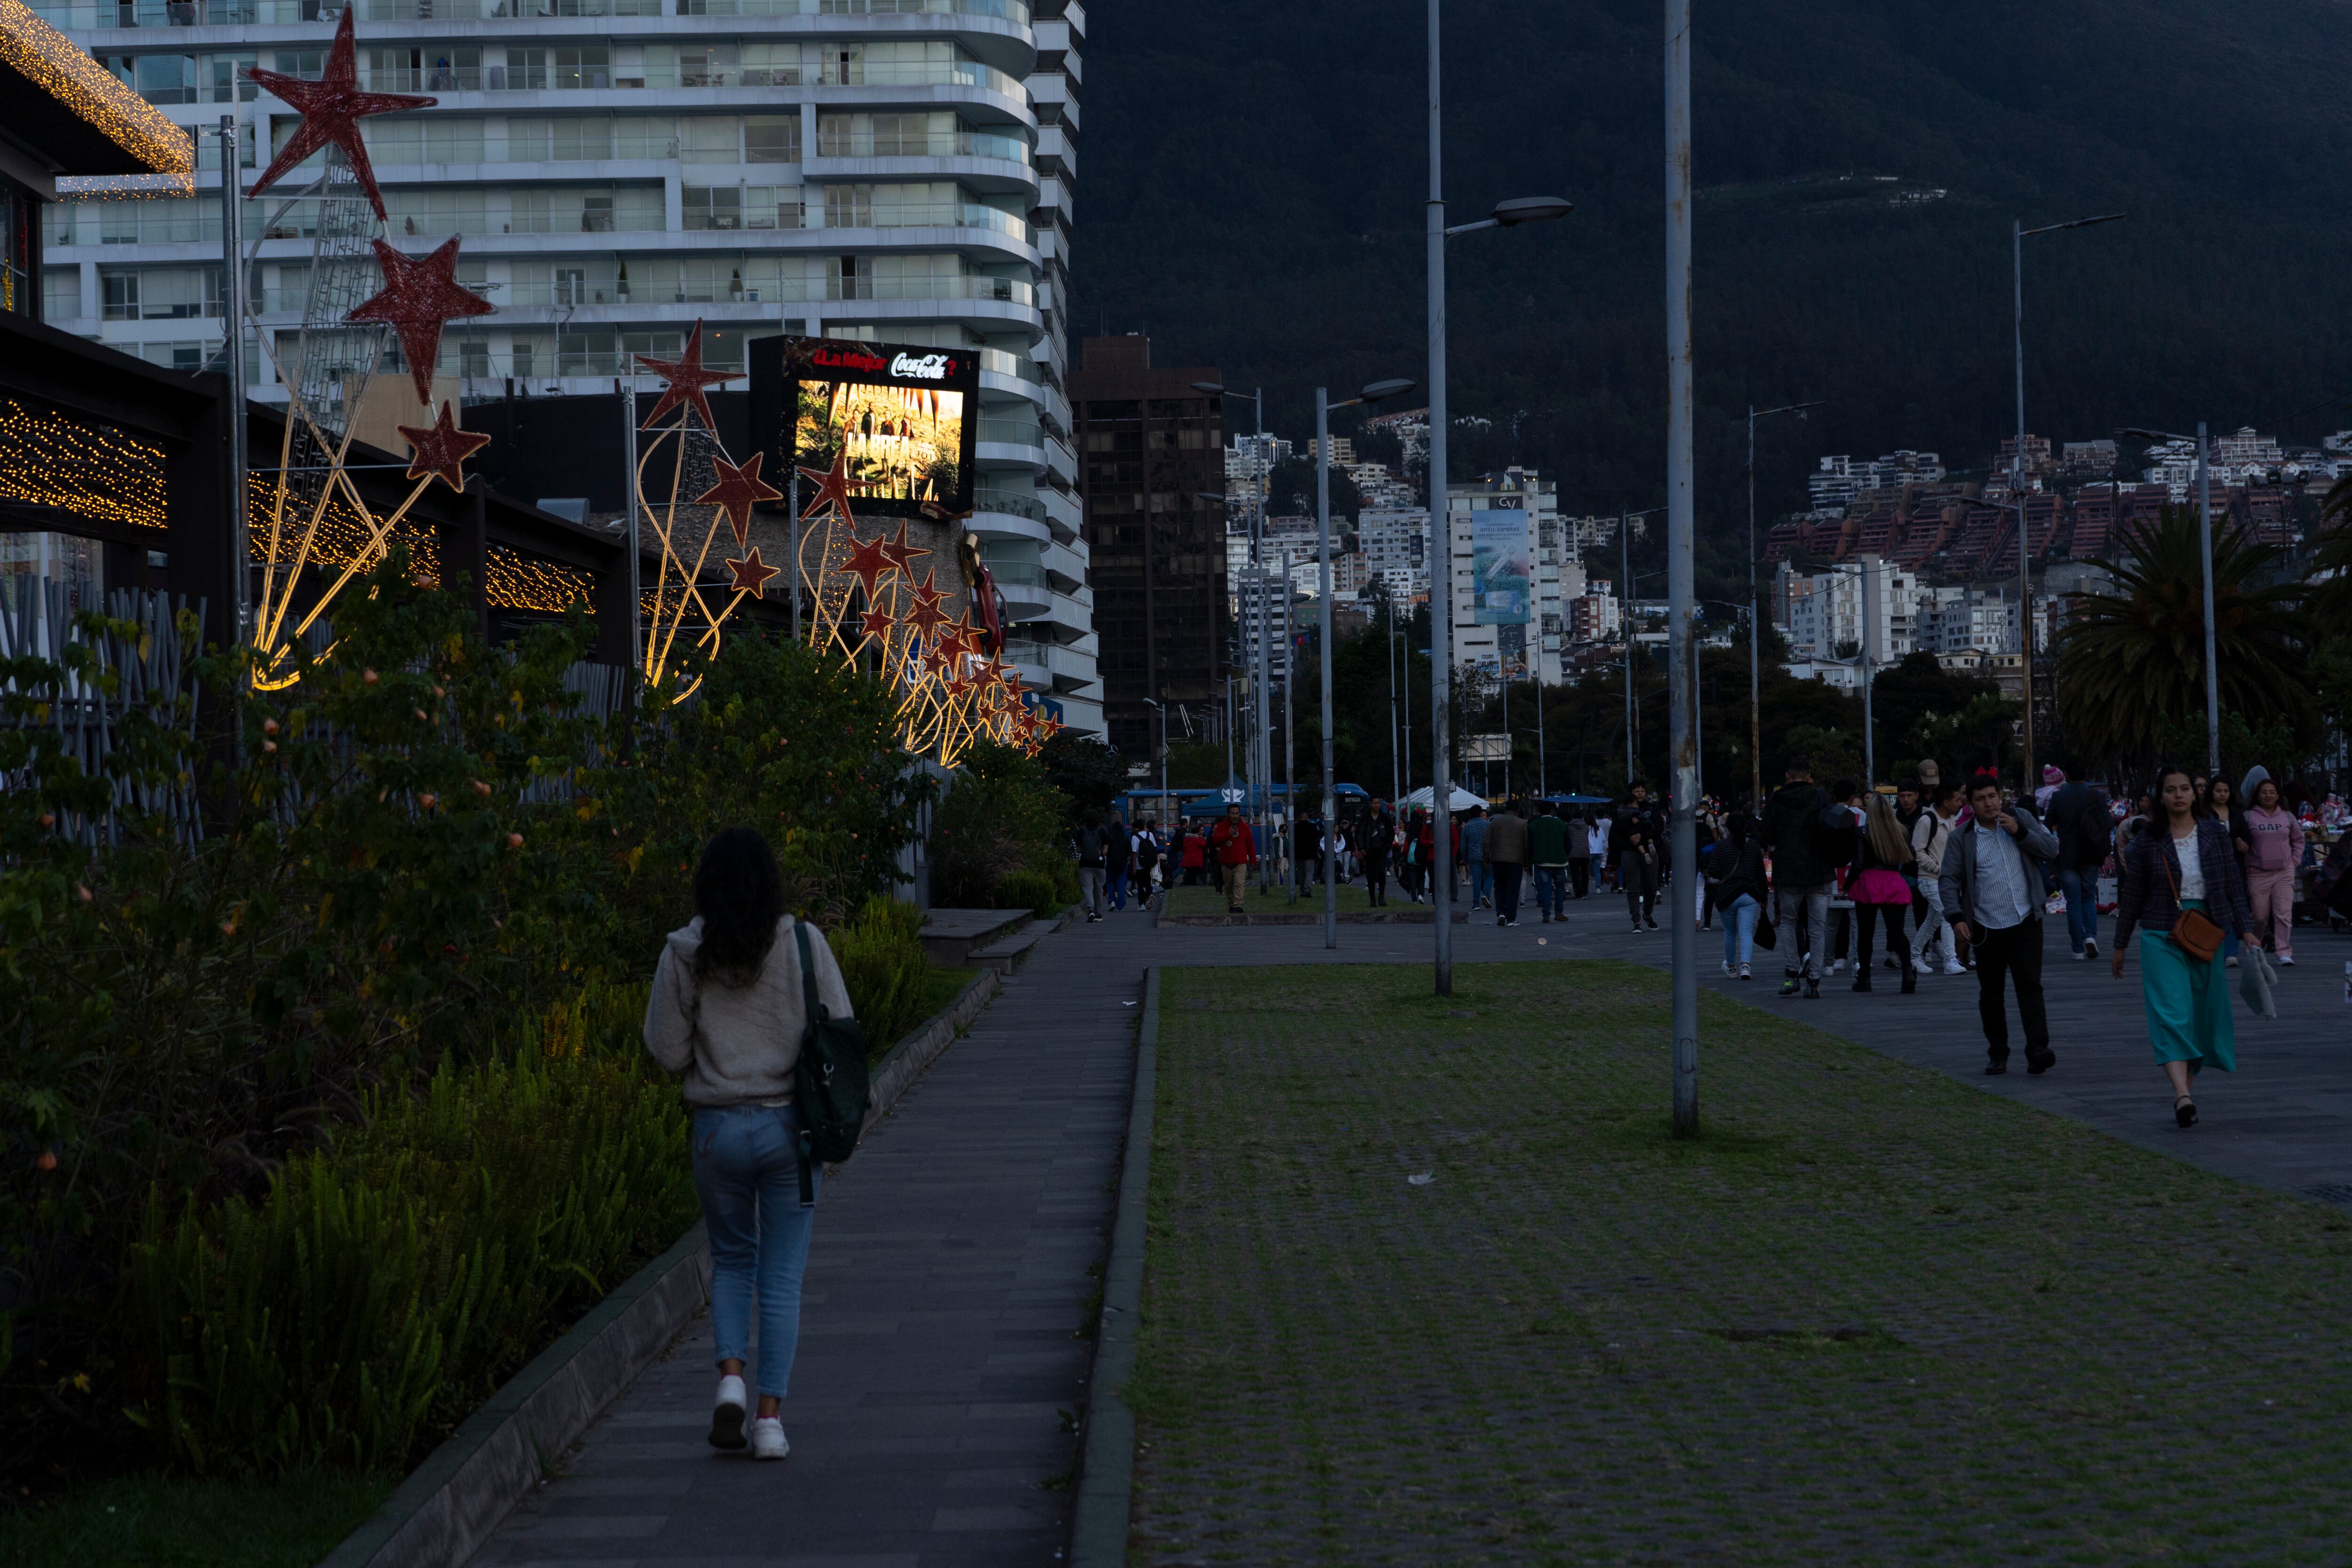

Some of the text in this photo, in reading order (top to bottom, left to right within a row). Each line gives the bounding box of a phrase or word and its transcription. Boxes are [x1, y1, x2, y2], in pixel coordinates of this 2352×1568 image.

[842, 352, 888, 373] Mejor
[891, 352, 949, 379] Coca-Cola
[847, 432, 910, 461] LA BREA
